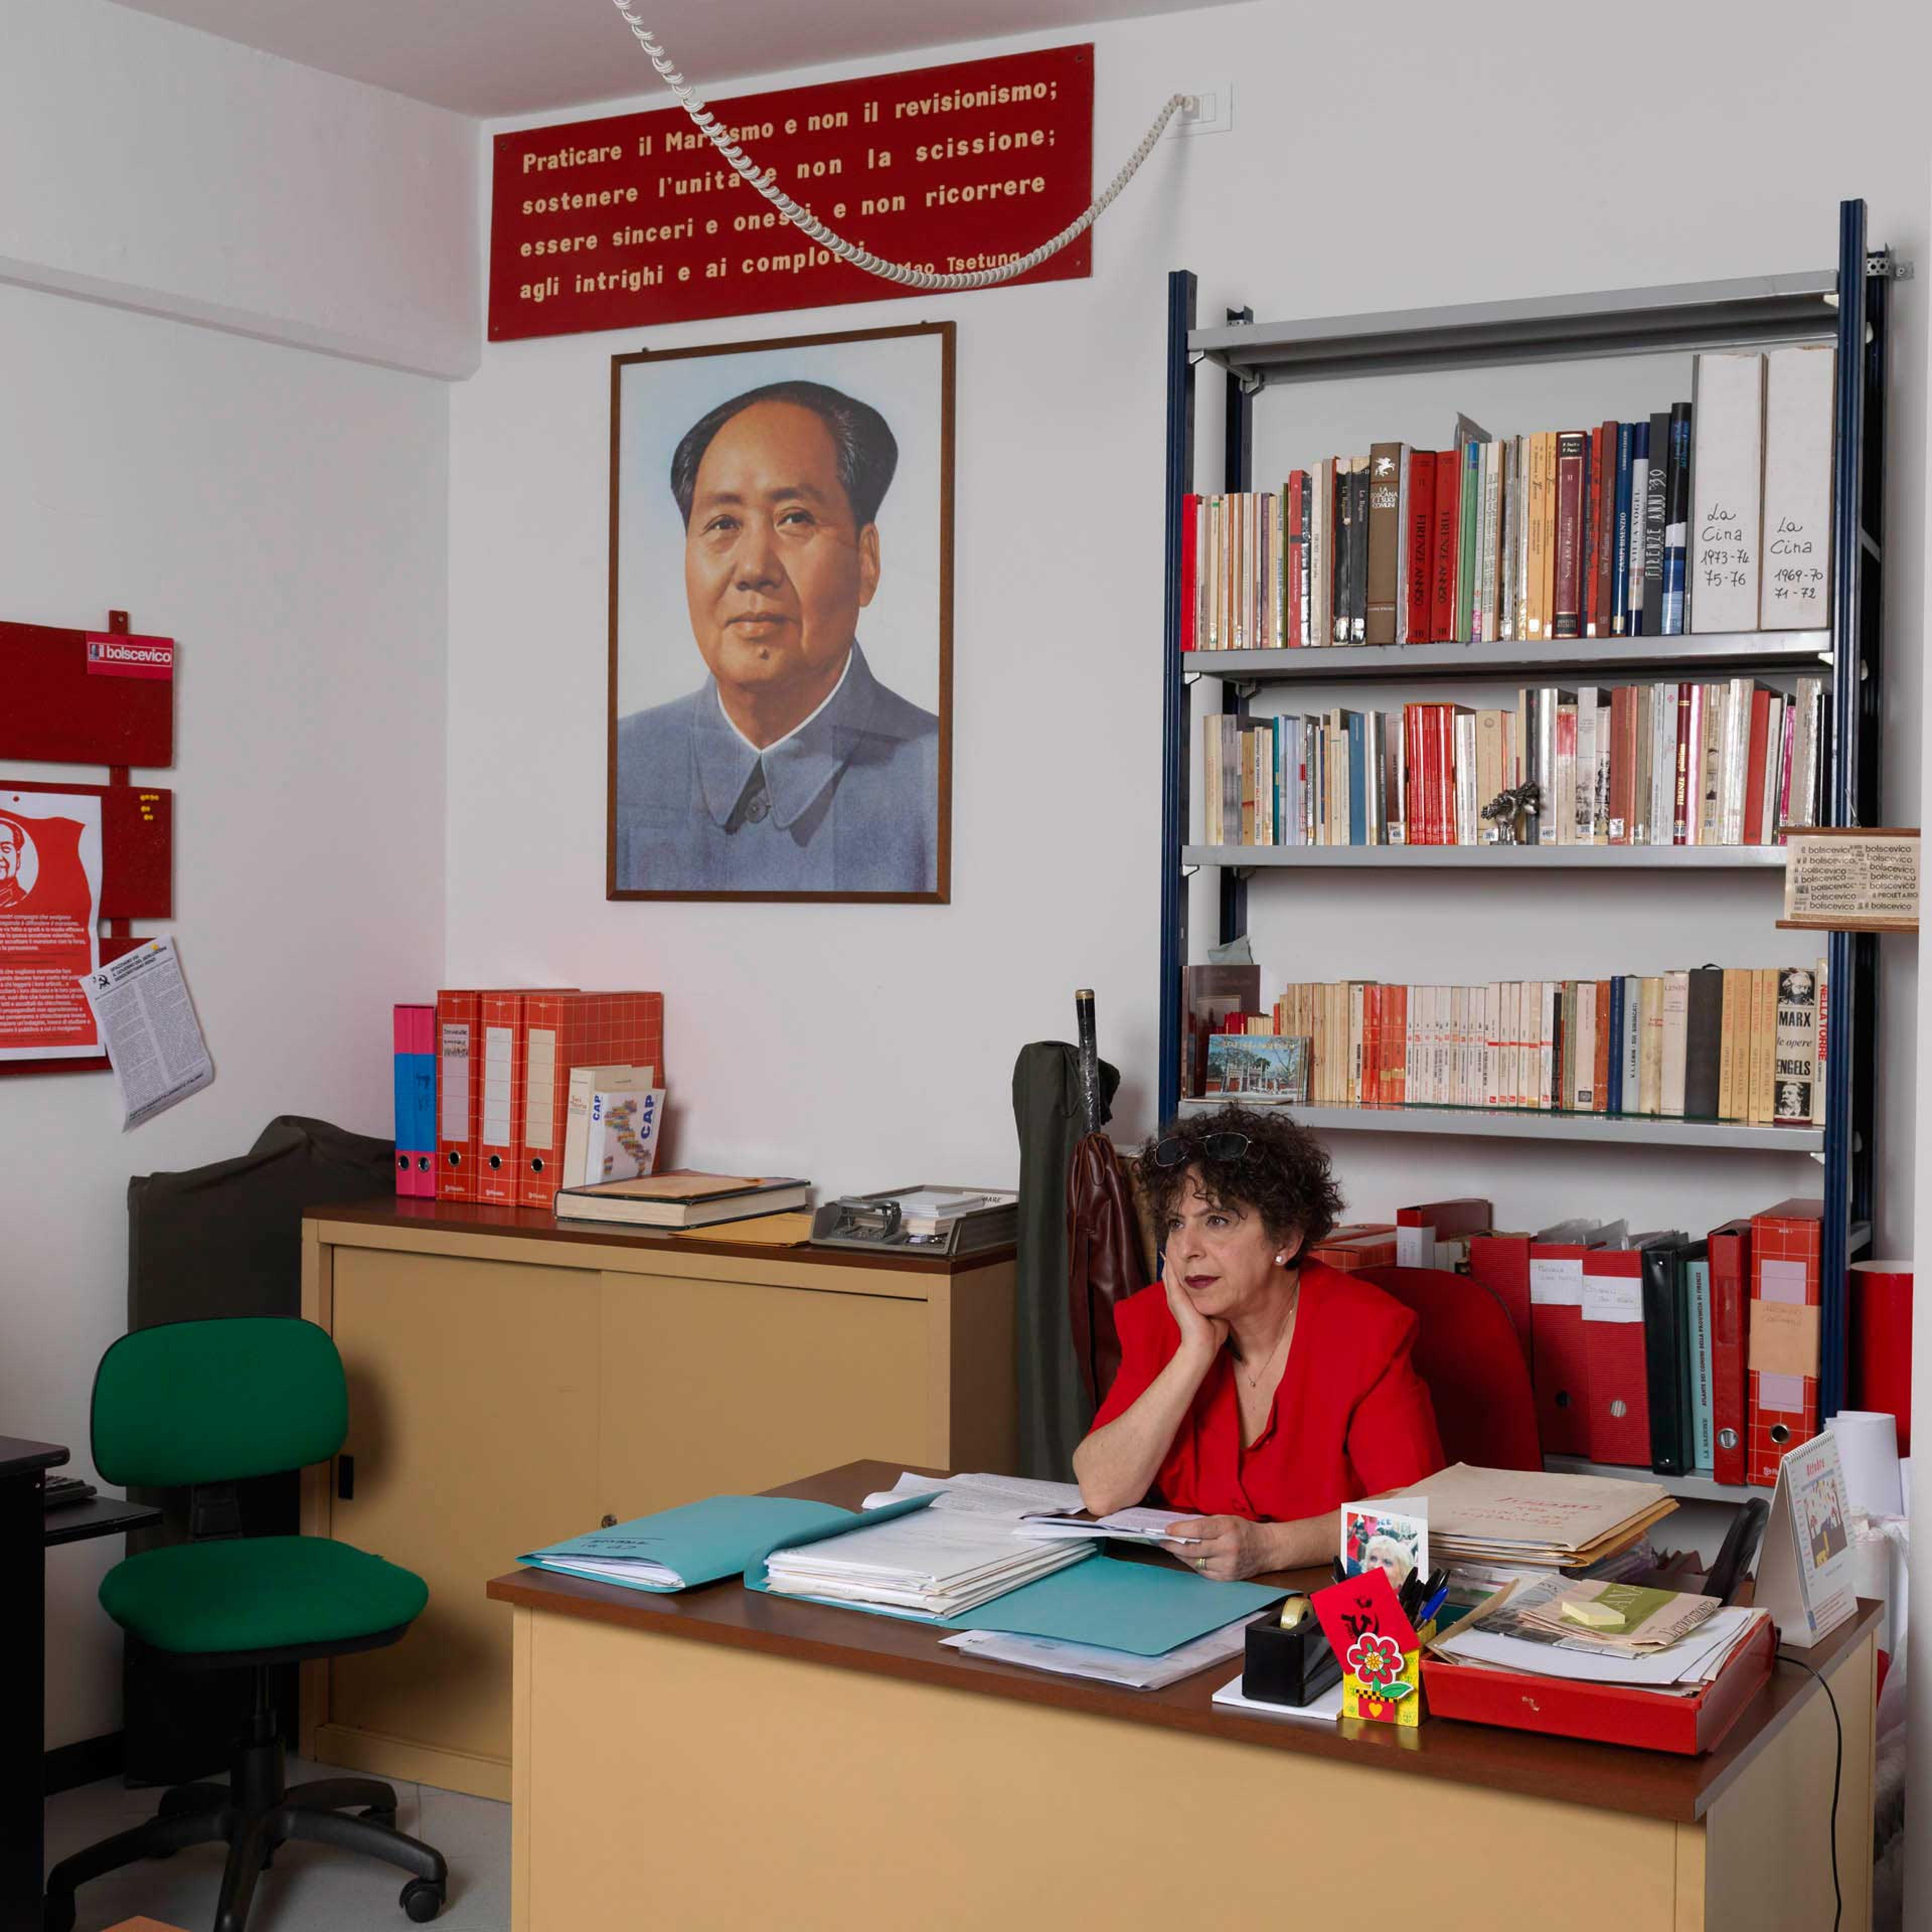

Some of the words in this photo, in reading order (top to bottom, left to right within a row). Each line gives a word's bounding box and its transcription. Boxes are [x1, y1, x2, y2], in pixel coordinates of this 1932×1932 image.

[523, 145, 622, 174] Praticare
[639, 136, 652, 156] il
[785, 119, 797, 134] e
[808, 112, 848, 130] non
[864, 102, 878, 122] il
[896, 82, 1057, 119] revisionismo;
[523, 187, 638, 215] sostenere
[797, 158, 842, 179] non
[868, 148, 891, 169] la
[916, 129, 1055, 162] scissione;
[520, 234, 598, 258] essere
[613, 218, 693, 246] sinceri
[706, 219, 718, 234] e
[834, 203, 846, 218] e
[862, 195, 905, 215] non
[926, 176, 1045, 207] ricorrere
[520, 277, 559, 303] agli
[576, 265, 663, 292] intrighi
[678, 266, 690, 281] e
[706, 258, 727, 279] ai
[1648, 494, 1665, 522] ANNI
[1707, 503, 1737, 521] La
[1777, 516, 1803, 533] La
[1415, 514, 1426, 564] FIRENZE
[1440, 511, 1450, 559] FIRENZE
[1702, 526, 1742, 542] Cina
[1645, 529, 1663, 579] FIRENZE
[1770, 540, 1812, 554] Cina
[1701, 549, 1749, 565] 1973-74
[1705, 571, 1746, 587] 75-76
[1774, 569, 1824, 582] 1969-70
[1775, 586, 1817, 599] 71-72
[99, 645, 104, 658] il
[106, 648, 171, 663] bolscevico
[1865, 845, 1912, 853] bolscevico
[1810, 901, 1855, 910] bolscevico
[1664, 982, 1686, 991] LENIN
[1819, 984, 1827, 1021] NELLA
[1779, 1010, 1811, 1027] MARX
[1787, 1038, 1812, 1049] opere
[1818, 1023, 1827, 1062] TORRE
[1776, 1059, 1811, 1076] ENGELS
[593, 1095, 601, 1121] CAP
[640, 1094, 654, 1139] CAP
